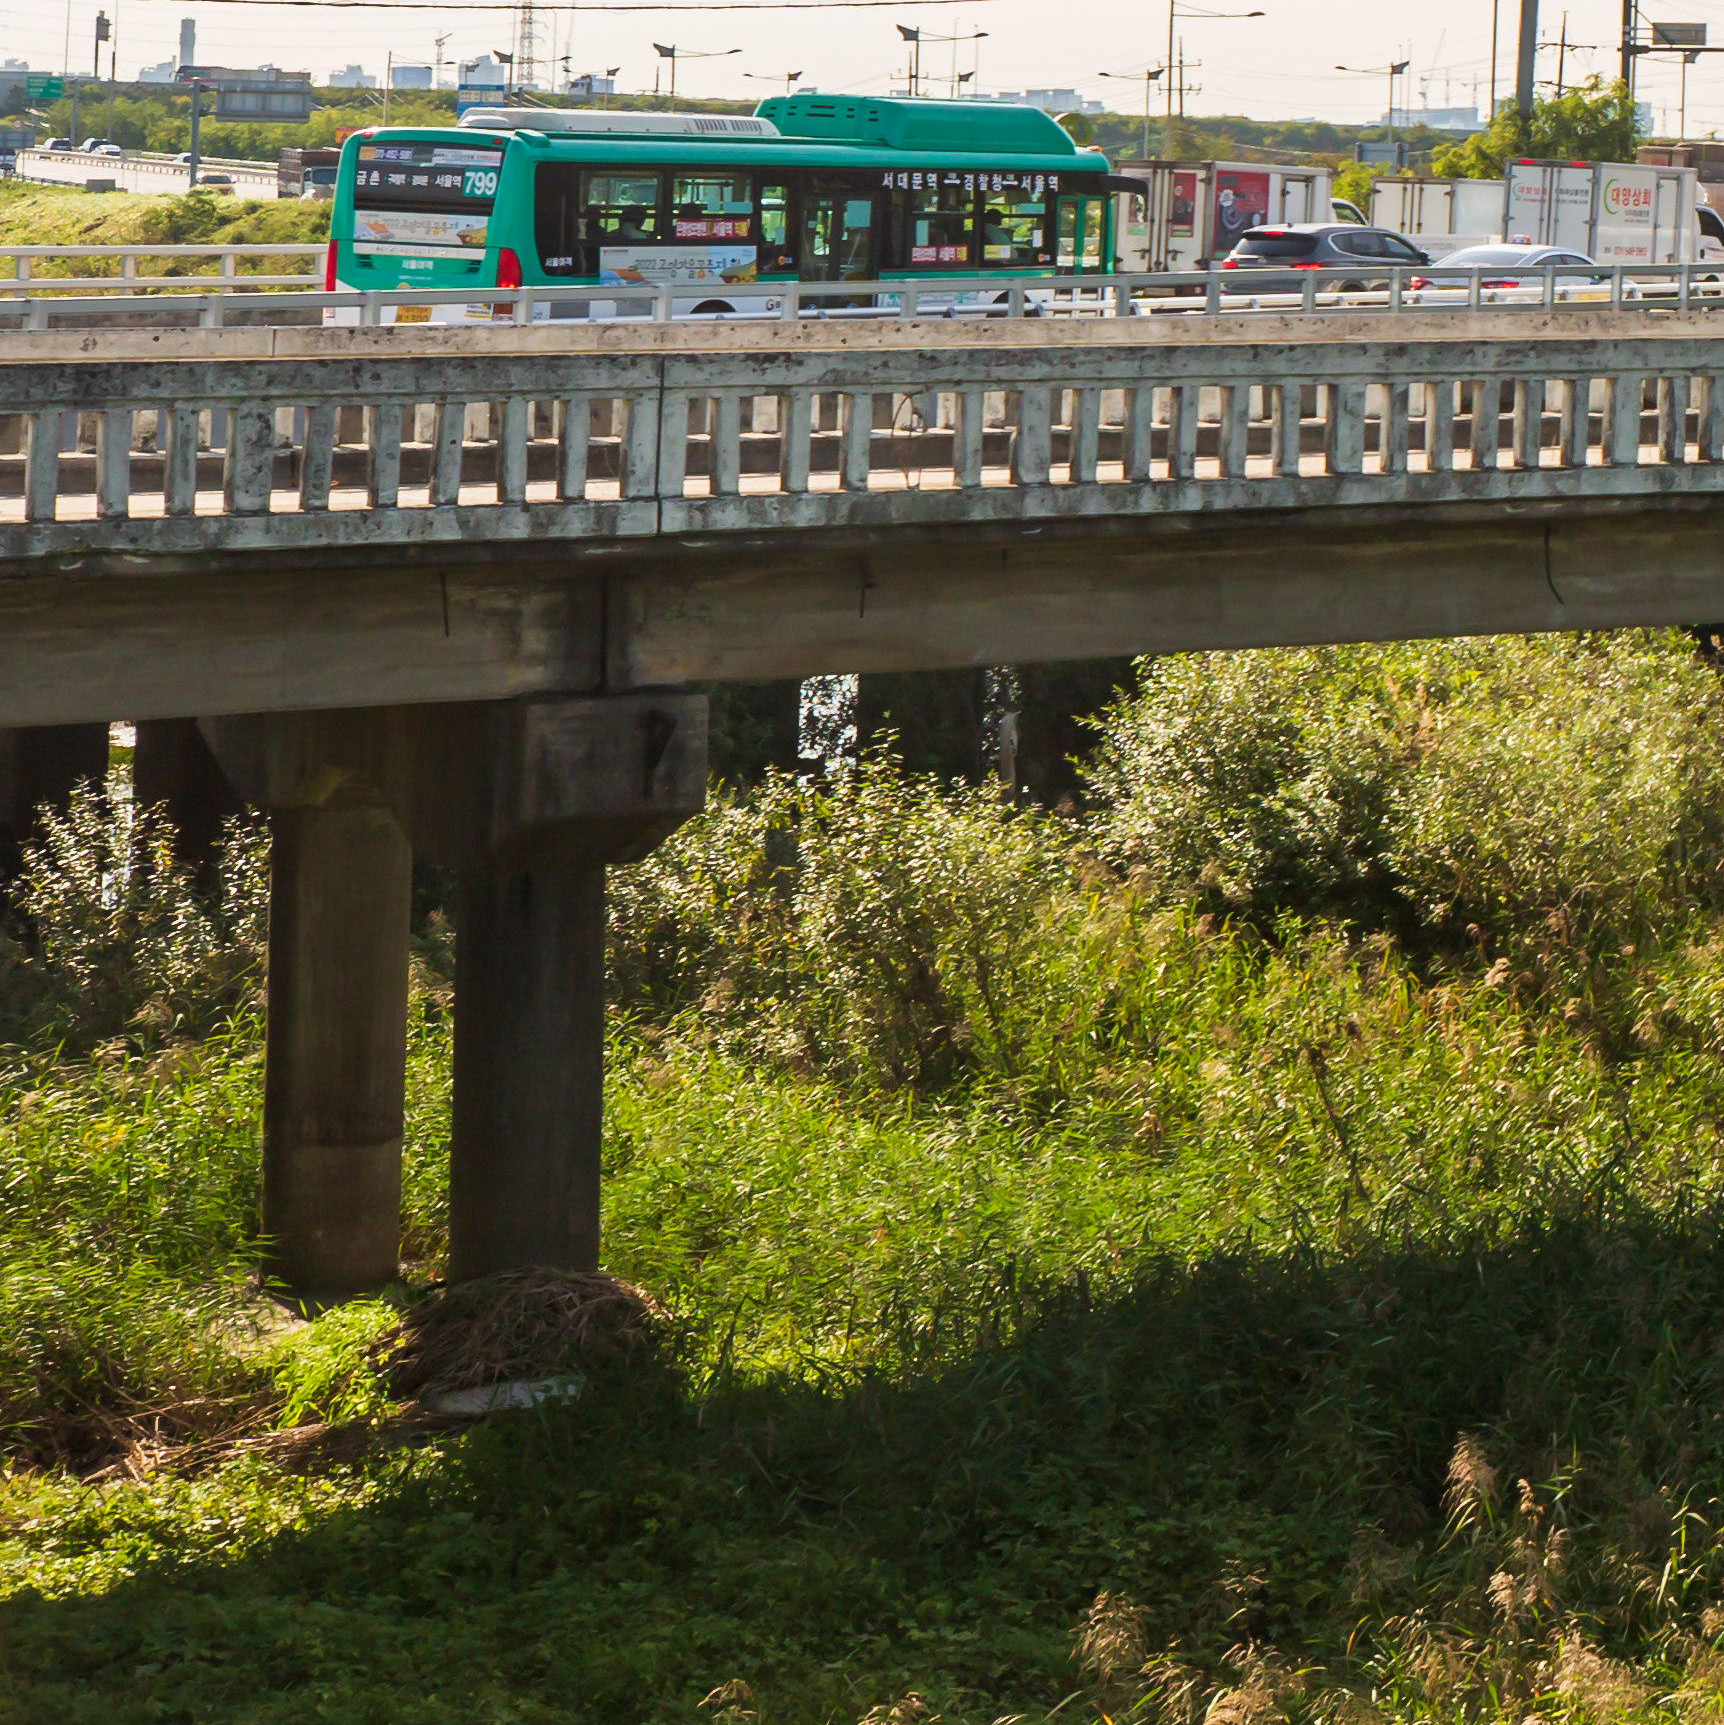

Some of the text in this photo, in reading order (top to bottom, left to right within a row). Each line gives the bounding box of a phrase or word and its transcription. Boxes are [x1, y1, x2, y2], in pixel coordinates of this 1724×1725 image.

[434, 174, 462, 188] 서울역
[464, 171, 498, 196] 799
[881, 171, 1059, 193] 서대문역 경찰청 서울역
[1610, 187, 1652, 207] 대양상회
[1418, 242, 1457, 251] YUNDAI
[634, 258, 657, 269] 2022
